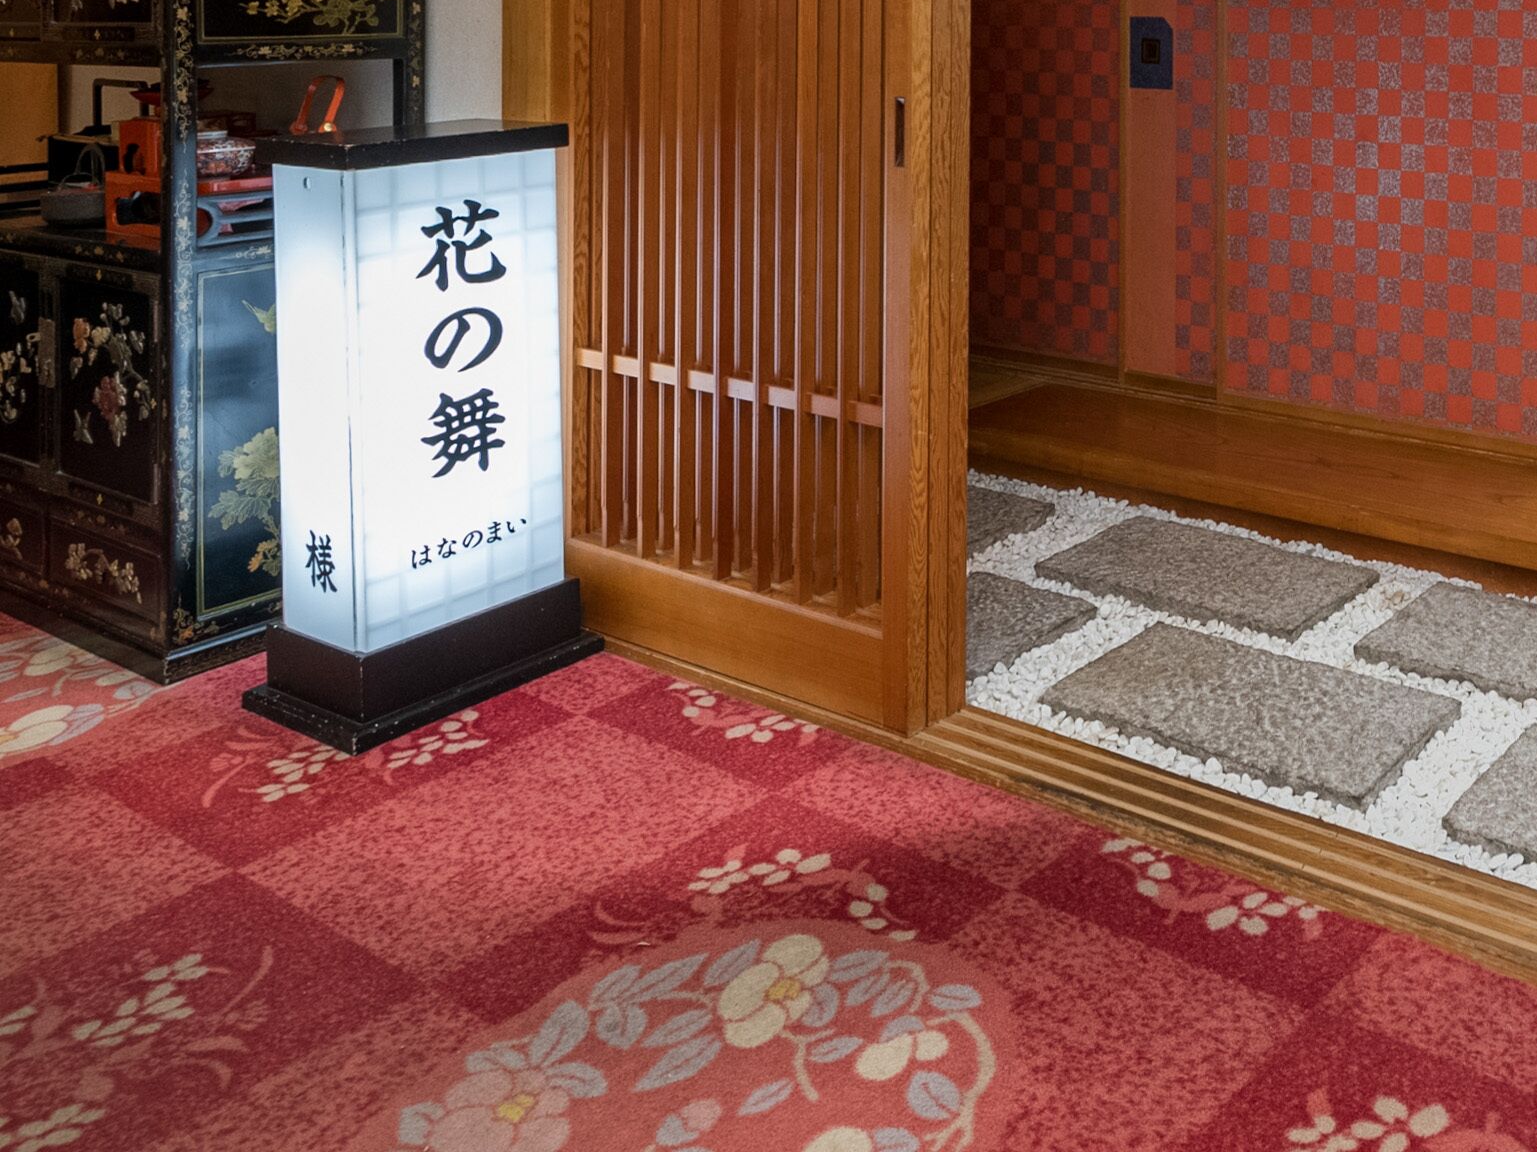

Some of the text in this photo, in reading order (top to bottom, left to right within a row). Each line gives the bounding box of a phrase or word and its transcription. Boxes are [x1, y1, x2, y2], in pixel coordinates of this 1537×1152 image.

[415, 199, 507, 479] 花の舞
[305, 529, 338, 594] 様
[411, 517, 527, 569] はなのまい
